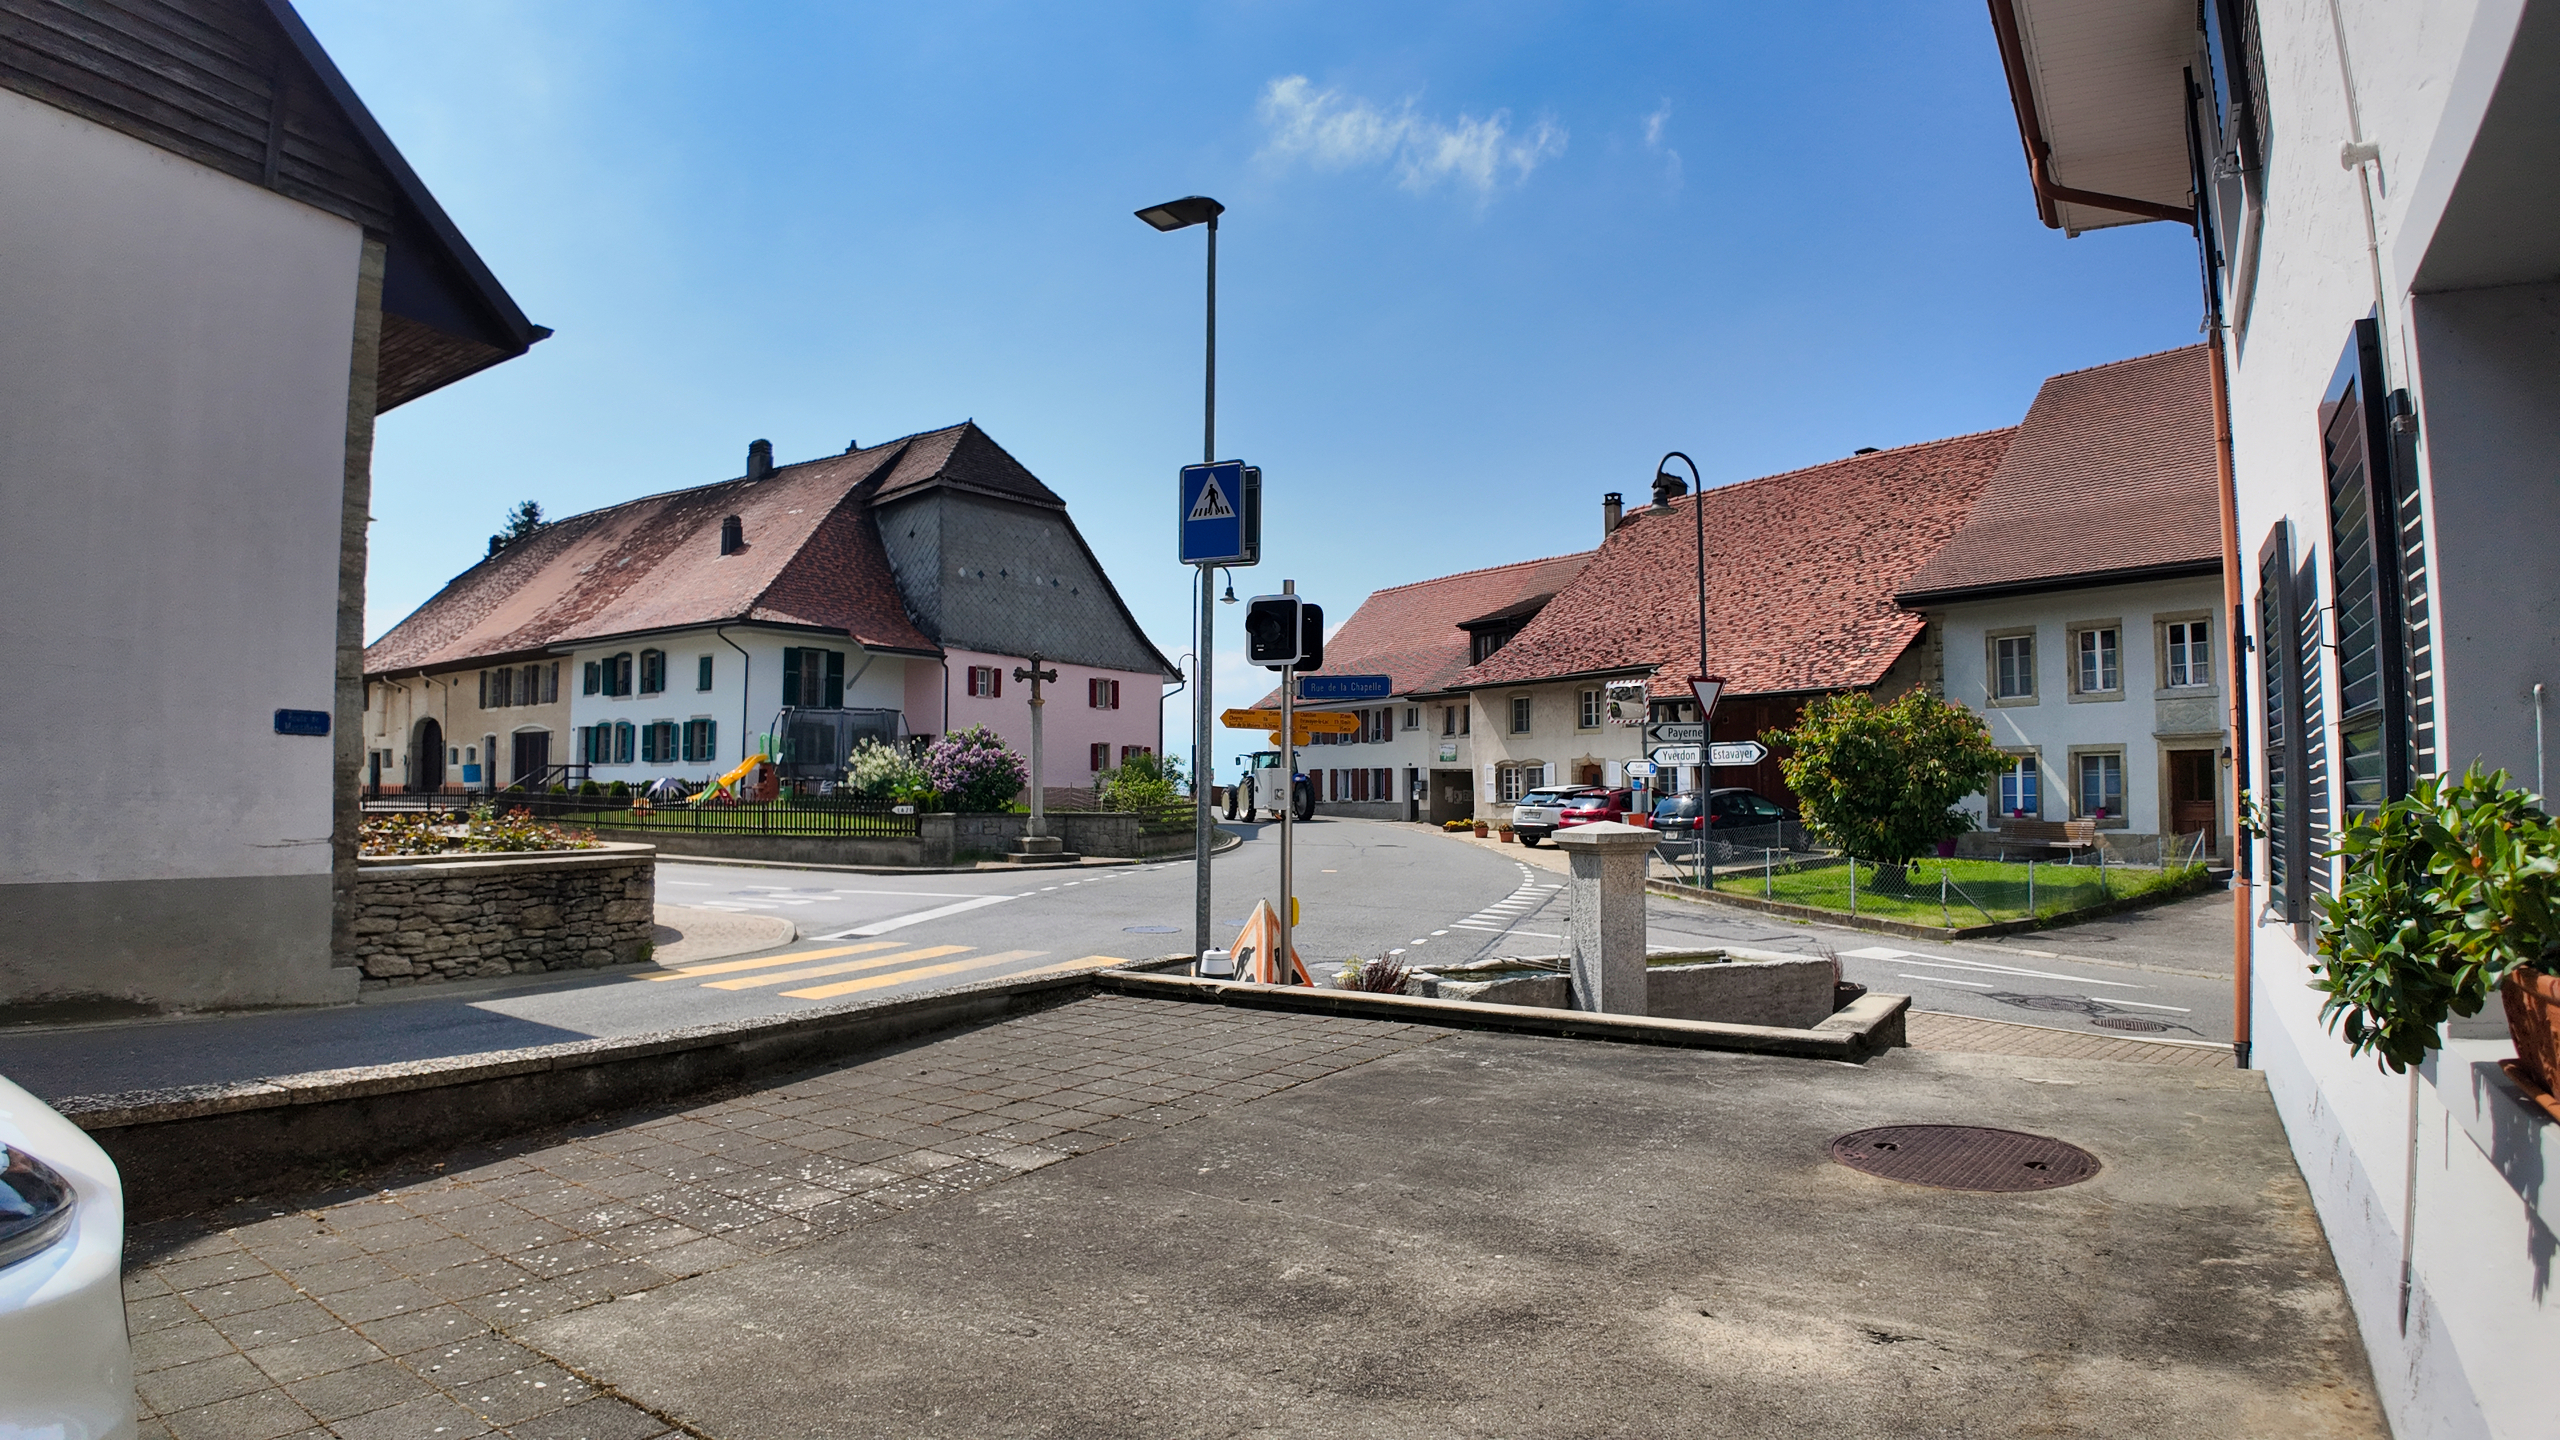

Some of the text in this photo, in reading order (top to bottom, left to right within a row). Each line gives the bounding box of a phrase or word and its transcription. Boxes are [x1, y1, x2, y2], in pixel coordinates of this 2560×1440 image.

[1311, 682, 1382, 694] Rue de la Chapelle
[1668, 728, 1703, 741] Payerne
[1663, 750, 1696, 761] Yverdon
[1713, 749, 1753, 763] Estavayer
